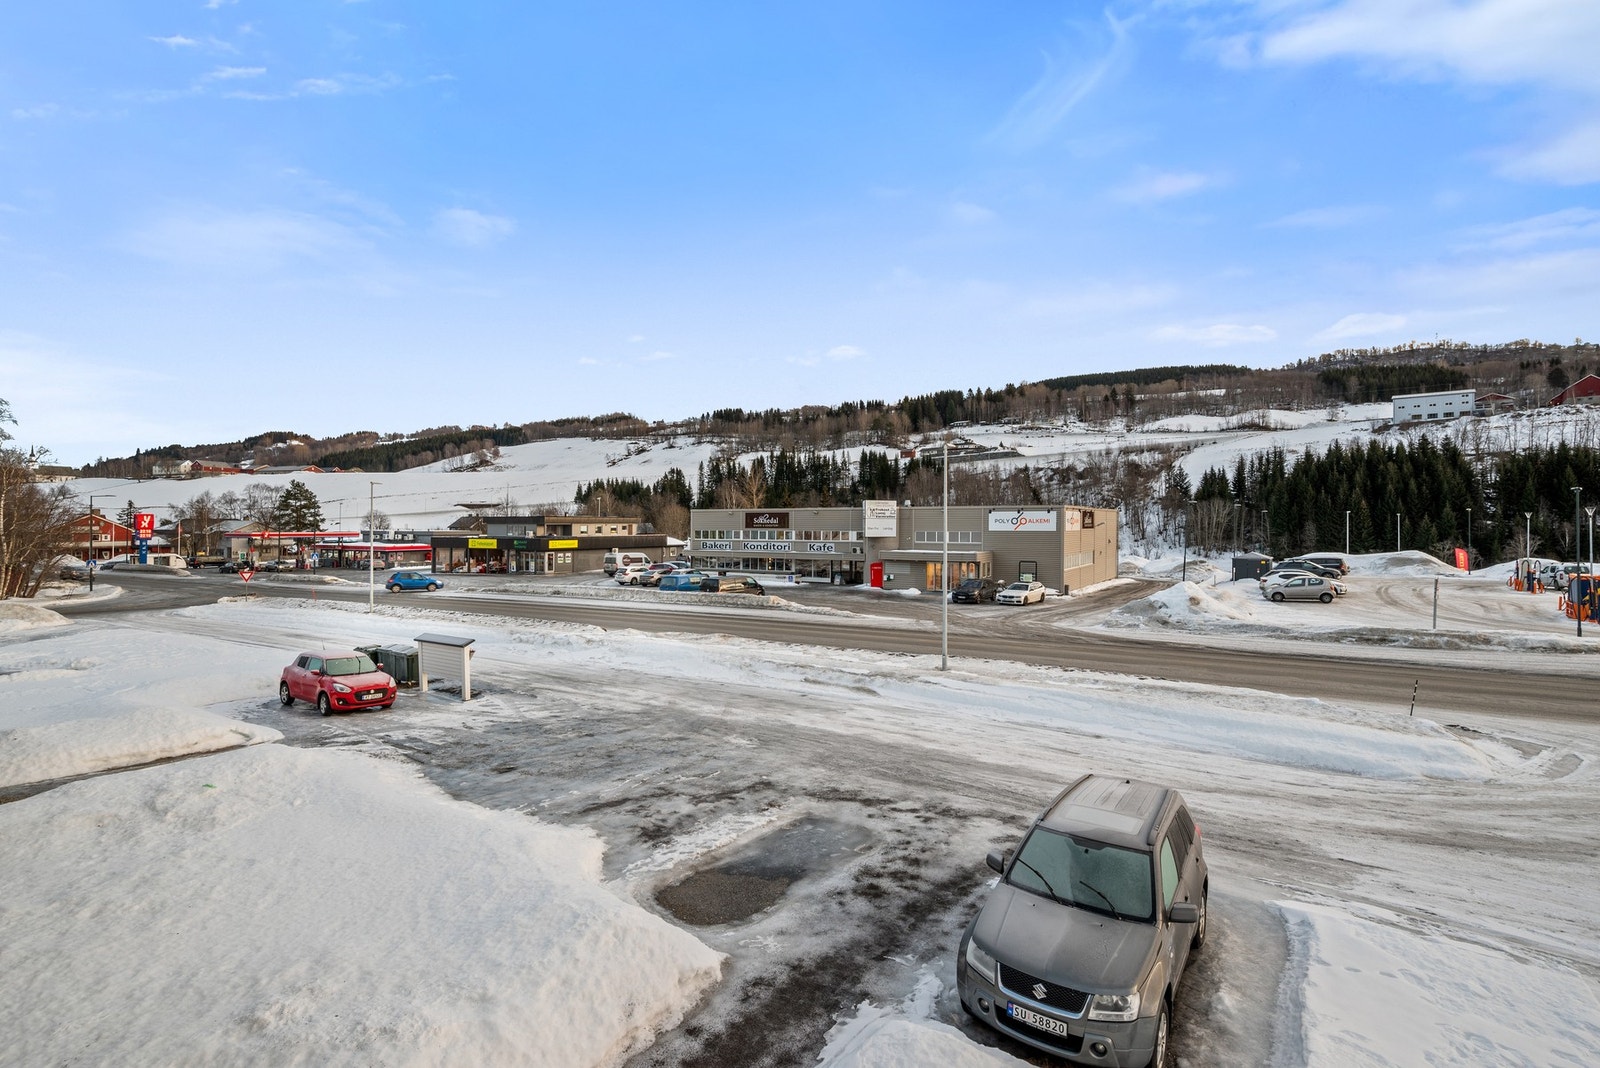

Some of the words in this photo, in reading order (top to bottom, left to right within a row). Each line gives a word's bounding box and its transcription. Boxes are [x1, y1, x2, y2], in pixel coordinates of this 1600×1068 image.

[701, 541, 731, 549] Bakeri
[743, 542, 791, 551] Konditori
[809, 543, 834, 552] Kafe
[1014, 1007, 1027, 1020] SU
[1032, 1014, 1065, 1034] 58820
